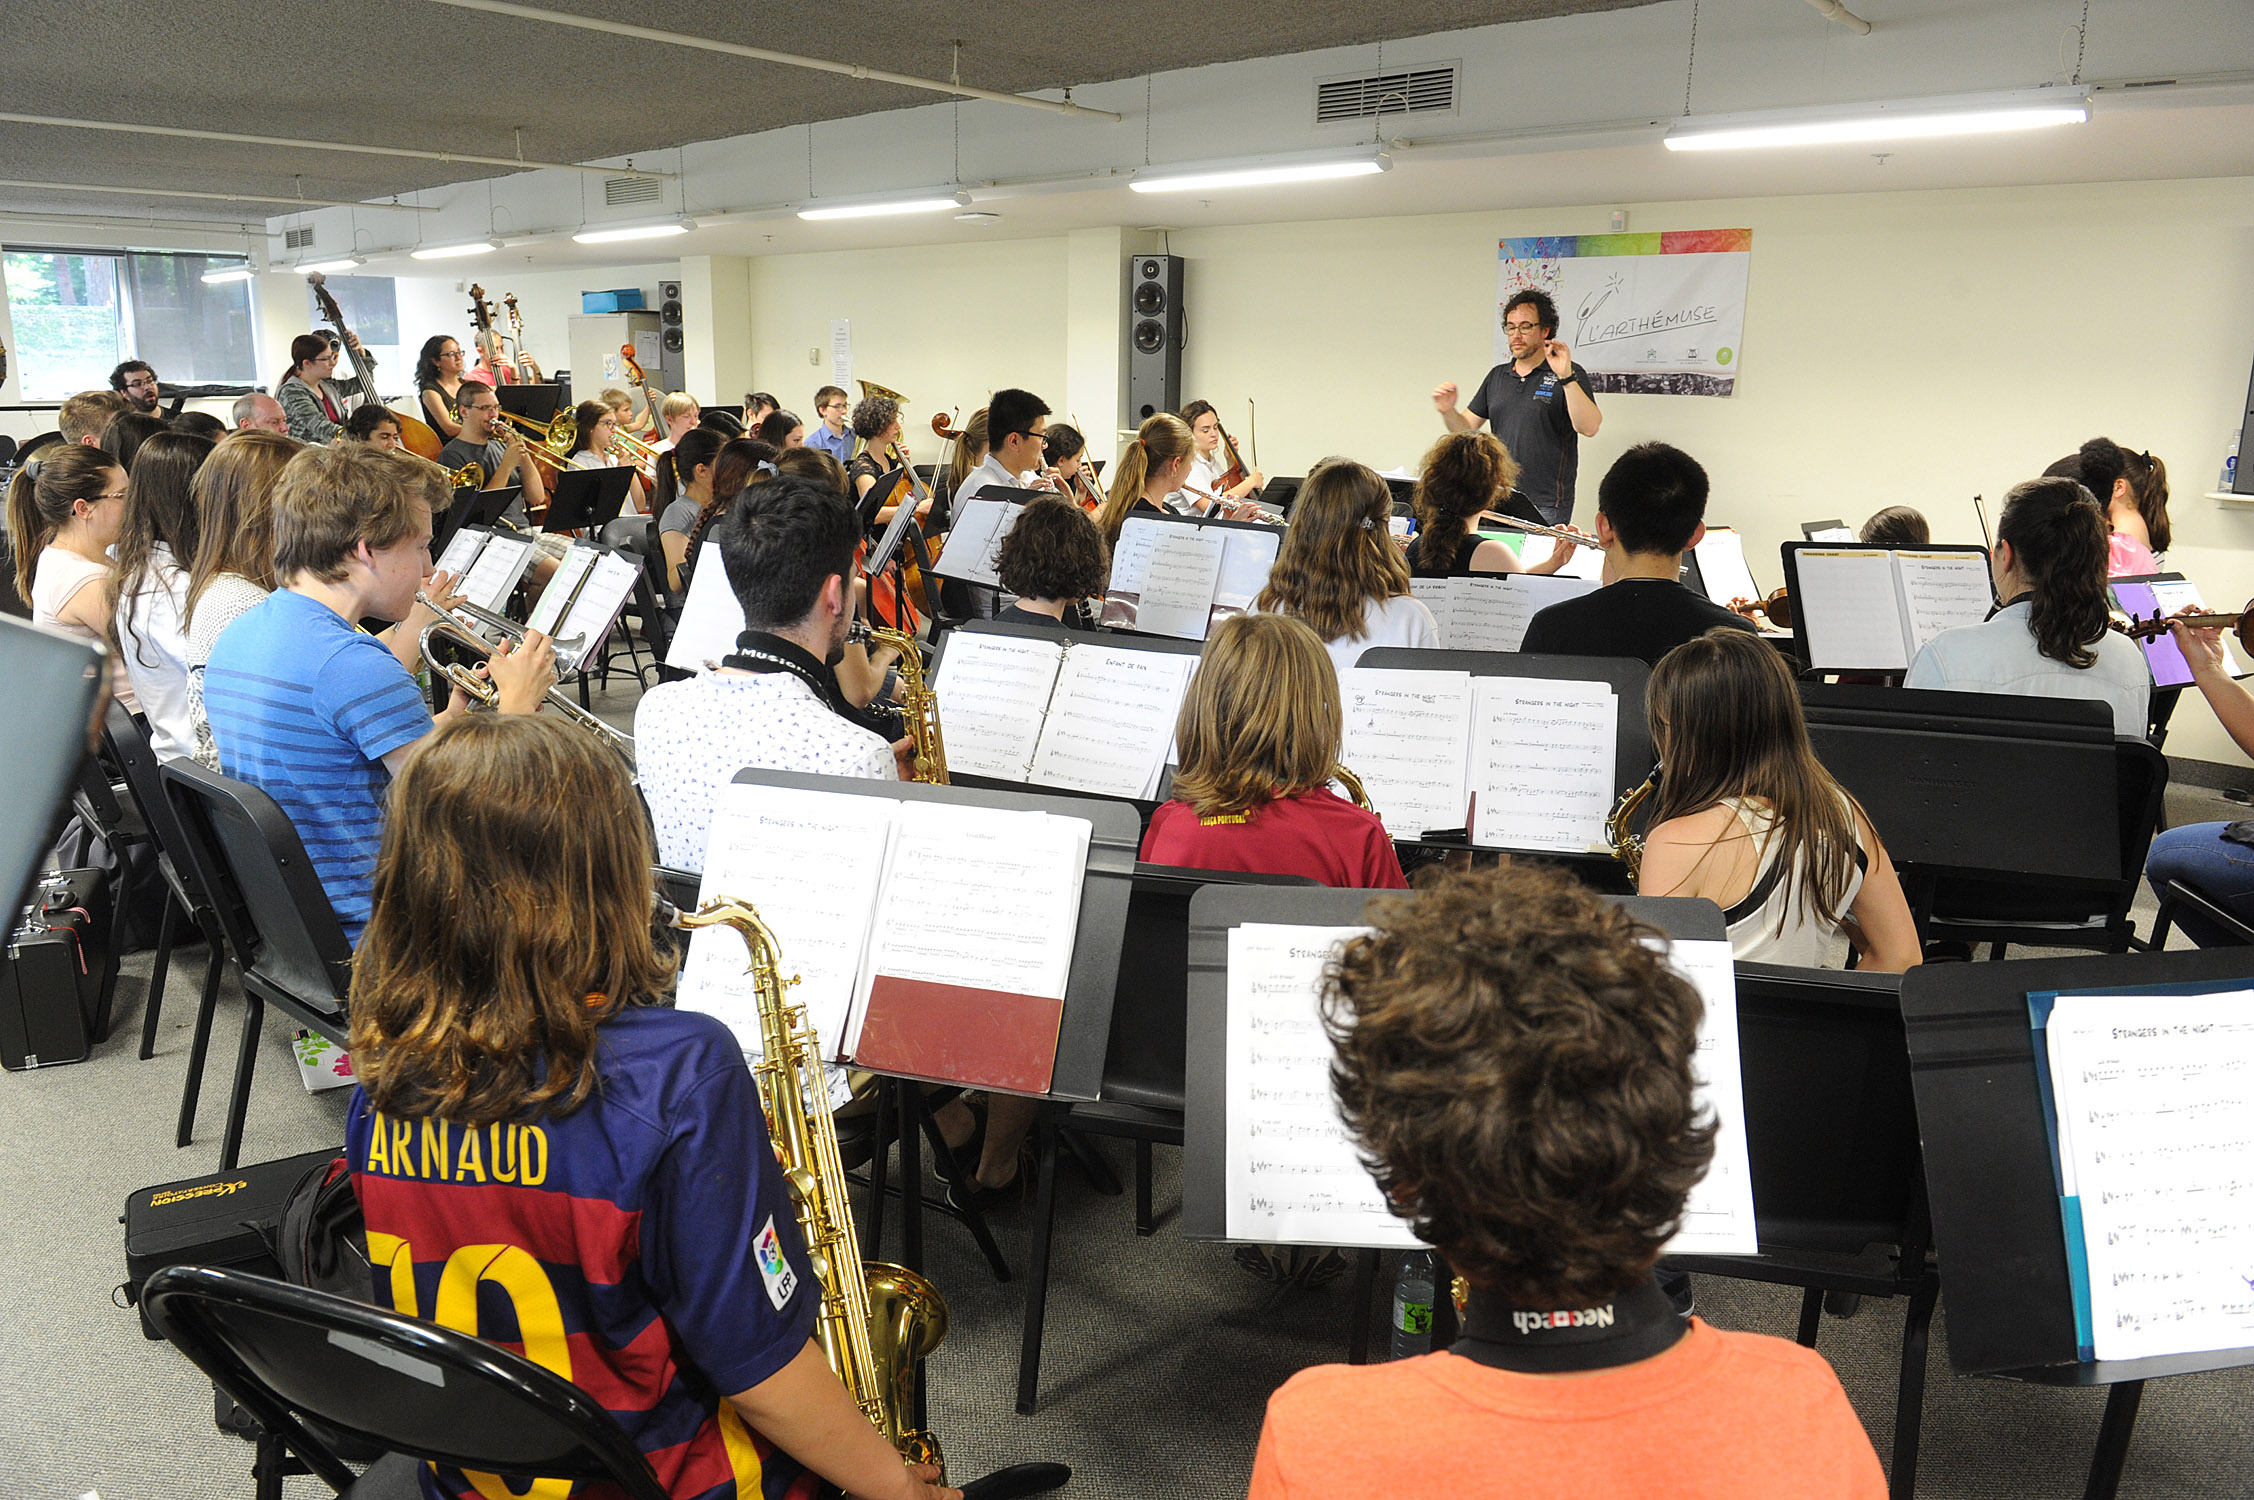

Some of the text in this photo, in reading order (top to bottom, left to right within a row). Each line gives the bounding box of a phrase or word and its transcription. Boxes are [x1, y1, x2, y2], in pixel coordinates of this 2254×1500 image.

[1514, 698, 1544, 706] STRANGERS
[1217, 814, 1246, 825] PORTUGAL
[2112, 1027, 2157, 1039] STRANGERS
[367, 1111, 548, 1186] ARNAUD
[777, 1271, 792, 1300] LFP
[1512, 1304, 1615, 1335] Neoech
